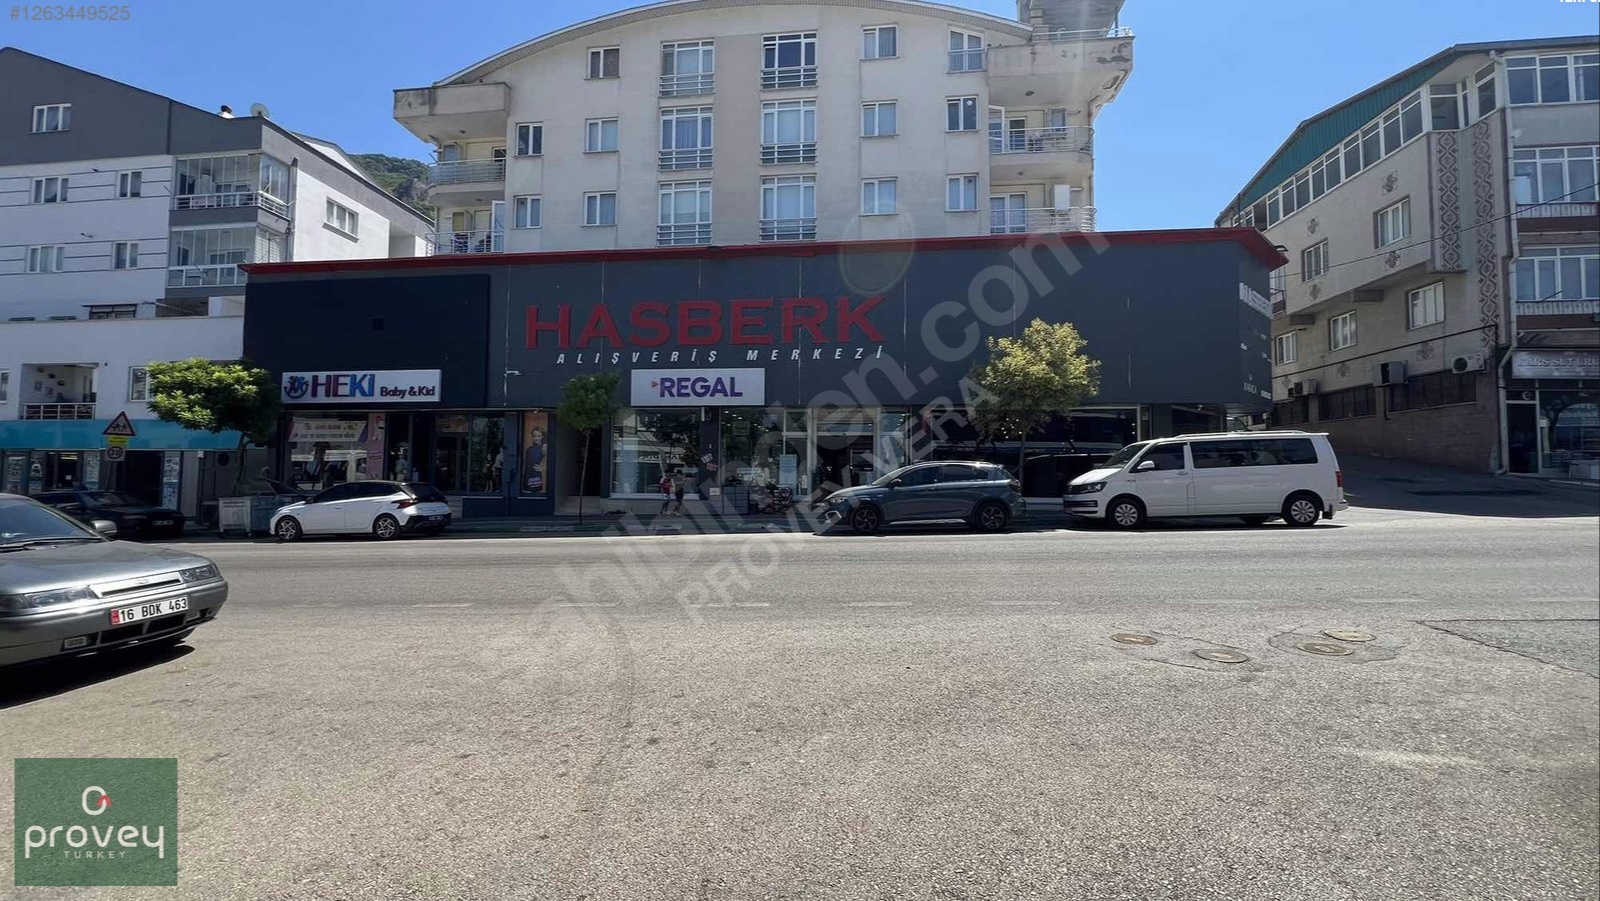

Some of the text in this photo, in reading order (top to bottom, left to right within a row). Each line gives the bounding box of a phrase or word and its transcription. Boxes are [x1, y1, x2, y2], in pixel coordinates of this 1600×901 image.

[524, 296, 886, 350] HASBERK
[556, 344, 884, 365] ALIŞVERİŞ MERKEZİ
[380, 385, 435, 398] Baby & Kid
[659, 377, 743, 398] REGAL
[121, 598, 187, 621] 16 BDK 463
